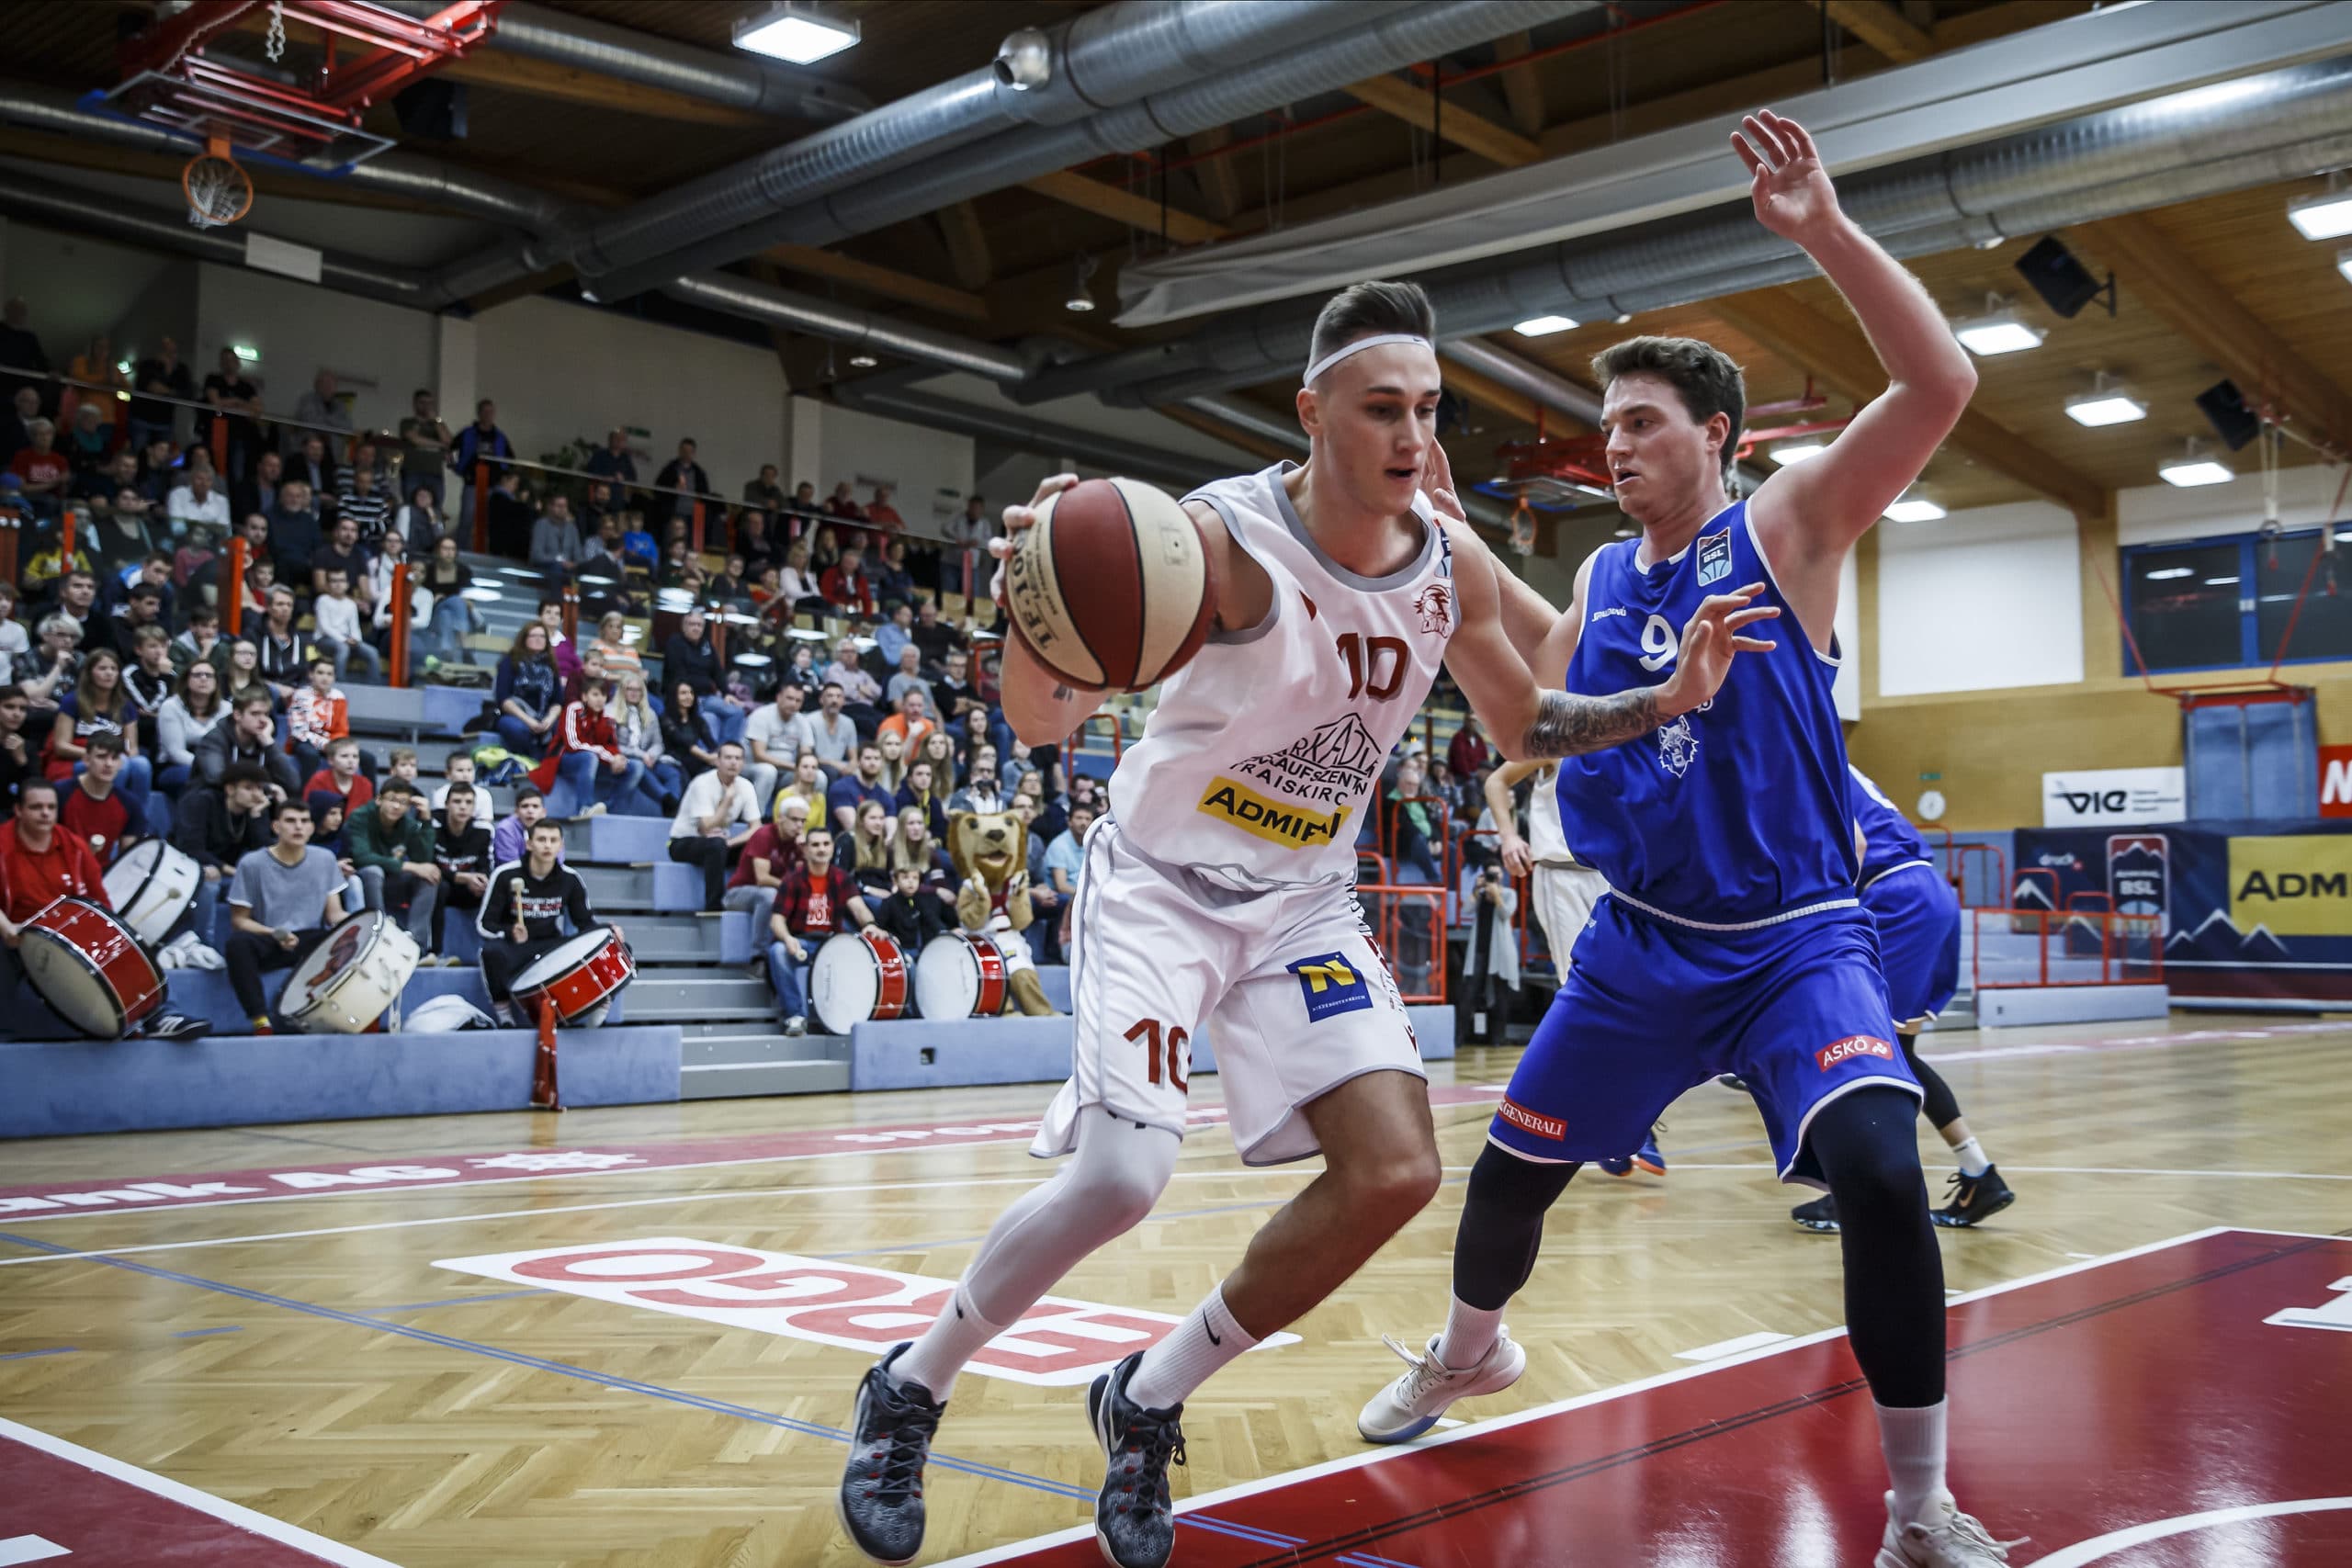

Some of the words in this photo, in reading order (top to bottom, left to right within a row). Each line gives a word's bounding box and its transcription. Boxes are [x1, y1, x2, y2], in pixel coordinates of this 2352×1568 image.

[1639, 614, 1679, 671] 9
[1336, 632, 1409, 702] 10
[2120, 879, 2158, 896] BSL
[1123, 1018, 1192, 1095] 10
[1823, 1036, 1868, 1066] ASKÖ
[1503, 1101, 1563, 1136] GENERALI
[269, 1165, 460, 1190] AG
